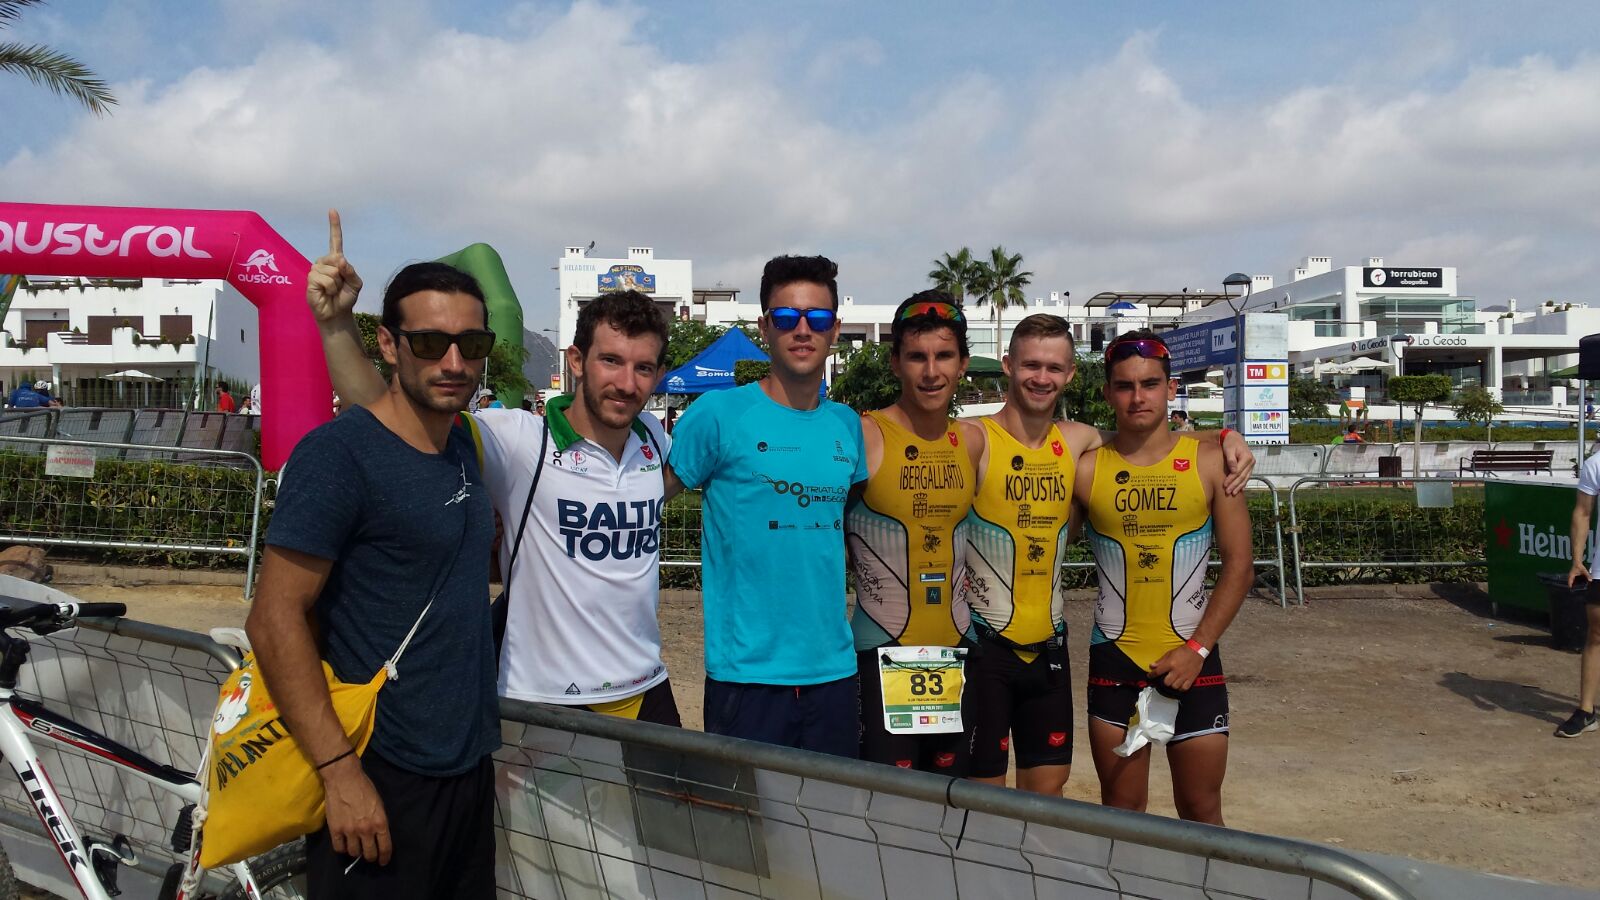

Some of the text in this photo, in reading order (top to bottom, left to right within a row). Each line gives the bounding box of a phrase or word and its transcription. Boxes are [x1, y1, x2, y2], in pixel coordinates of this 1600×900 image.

[611, 265, 643, 273] NEPTUNO
[1390, 270, 1438, 278] torrubiano
[237, 273, 293, 285] austral
[1358, 338, 1388, 351] La Geoda
[1418, 335, 1467, 346] La Geoda
[1249, 368, 1264, 377] TM
[1005, 474, 1066, 501] KOPUSTAS
[1114, 487, 1178, 512] GOMEZ
[559, 523, 661, 561] TOURS
[1518, 523, 1593, 563] Hein
[910, 673, 944, 696] 83
[20, 760, 88, 870] TREK
